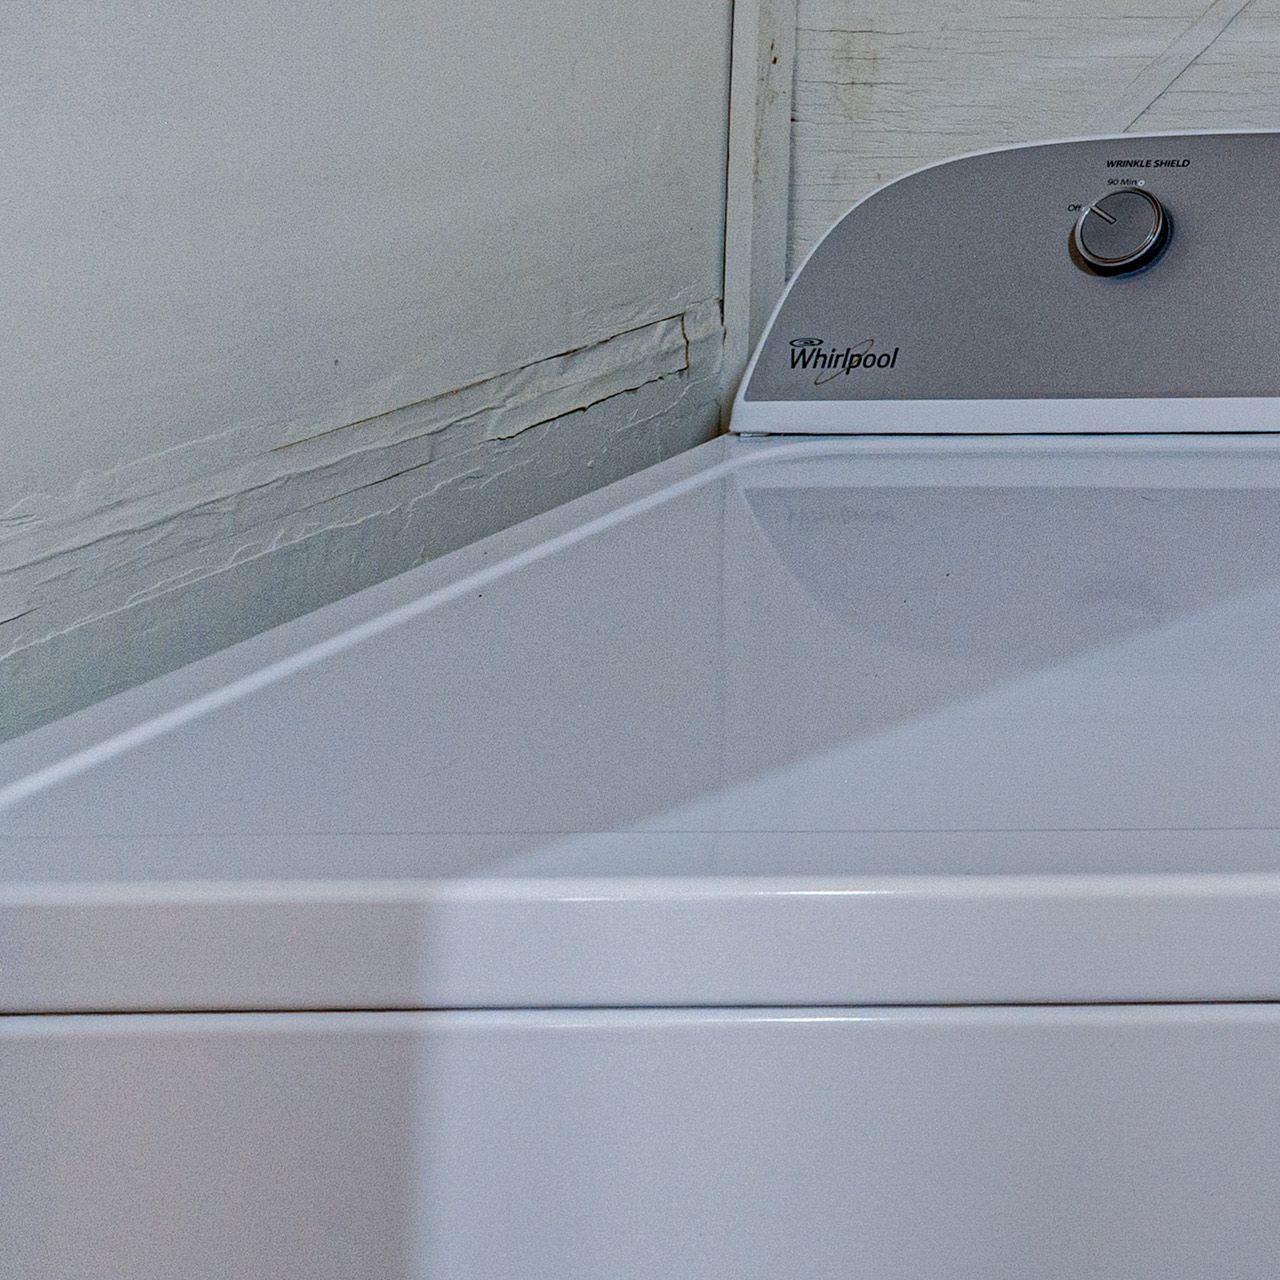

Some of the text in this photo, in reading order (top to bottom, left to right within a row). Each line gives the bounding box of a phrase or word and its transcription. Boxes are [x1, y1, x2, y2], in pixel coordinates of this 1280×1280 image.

[1106, 159, 1191, 168] WRINKLE SHIELD
[1121, 178, 1138, 186] Min
[1067, 203, 1082, 211] Off
[789, 346, 899, 375] Whirlpool
